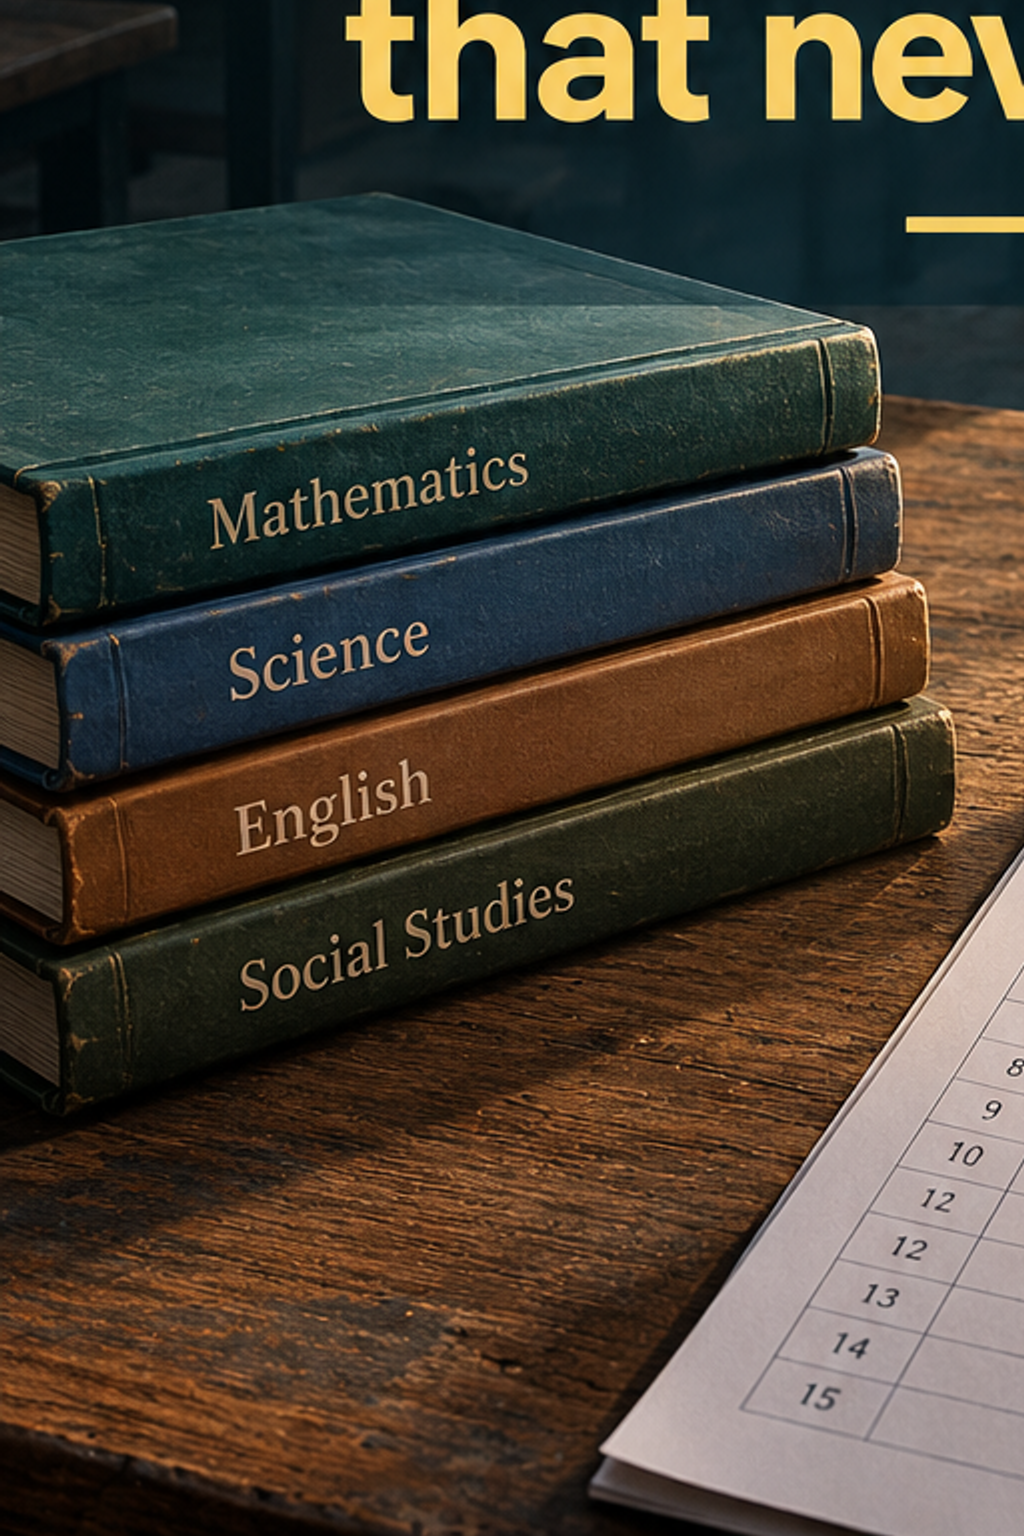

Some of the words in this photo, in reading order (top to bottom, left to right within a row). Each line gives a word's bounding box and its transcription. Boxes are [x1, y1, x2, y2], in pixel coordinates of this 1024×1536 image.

[208, 446, 531, 551] Mathematics
[229, 621, 429, 702] Science
[234, 759, 433, 858] English
[240, 919, 389, 1012] Social
[404, 875, 576, 960] Studies
[981, 1100, 1003, 1120] 9
[948, 1141, 984, 1167] 10
[921, 1188, 956, 1213] 12
[891, 1235, 928, 1261] 12
[862, 1283, 900, 1309] 13
[832, 1332, 870, 1360] 14
[800, 1383, 842, 1411] 15
